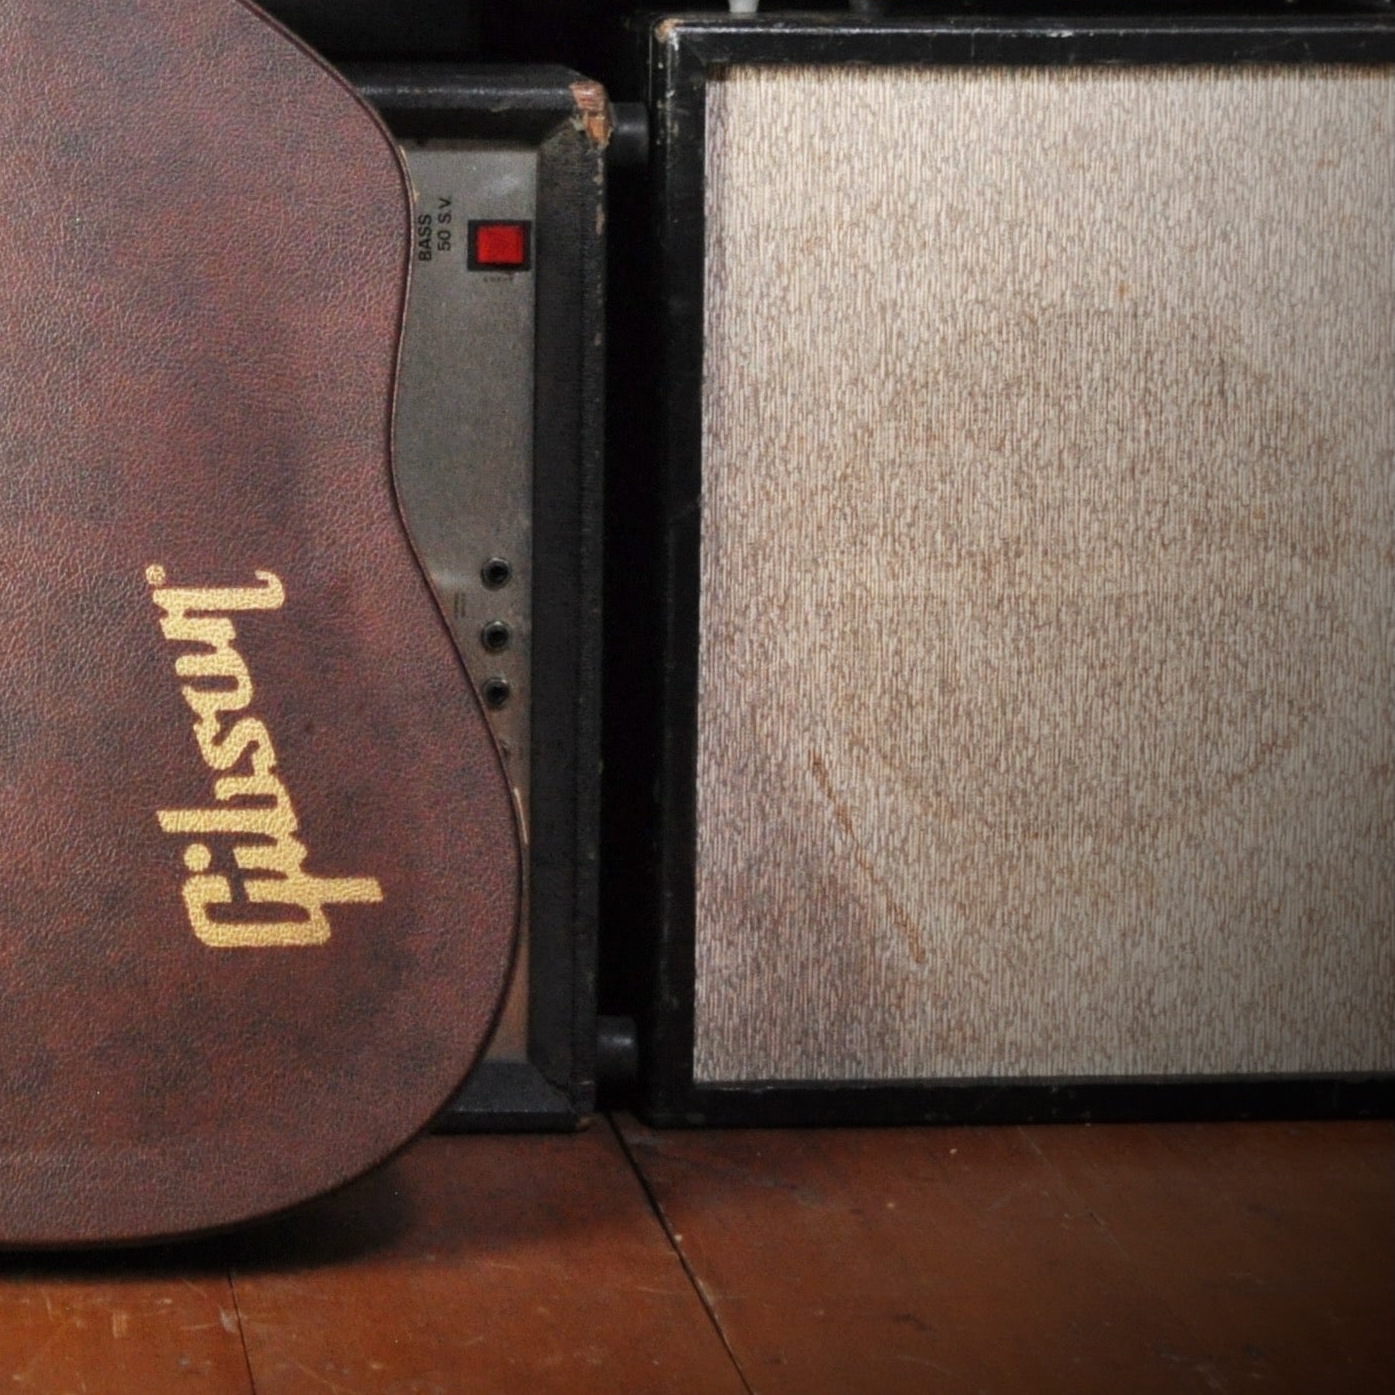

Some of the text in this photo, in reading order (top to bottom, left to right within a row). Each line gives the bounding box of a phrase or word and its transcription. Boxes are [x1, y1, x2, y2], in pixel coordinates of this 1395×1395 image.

[418, 214, 432, 261] BASS
[437, 229, 451, 252] 50
[150, 567, 384, 948] Gibson
